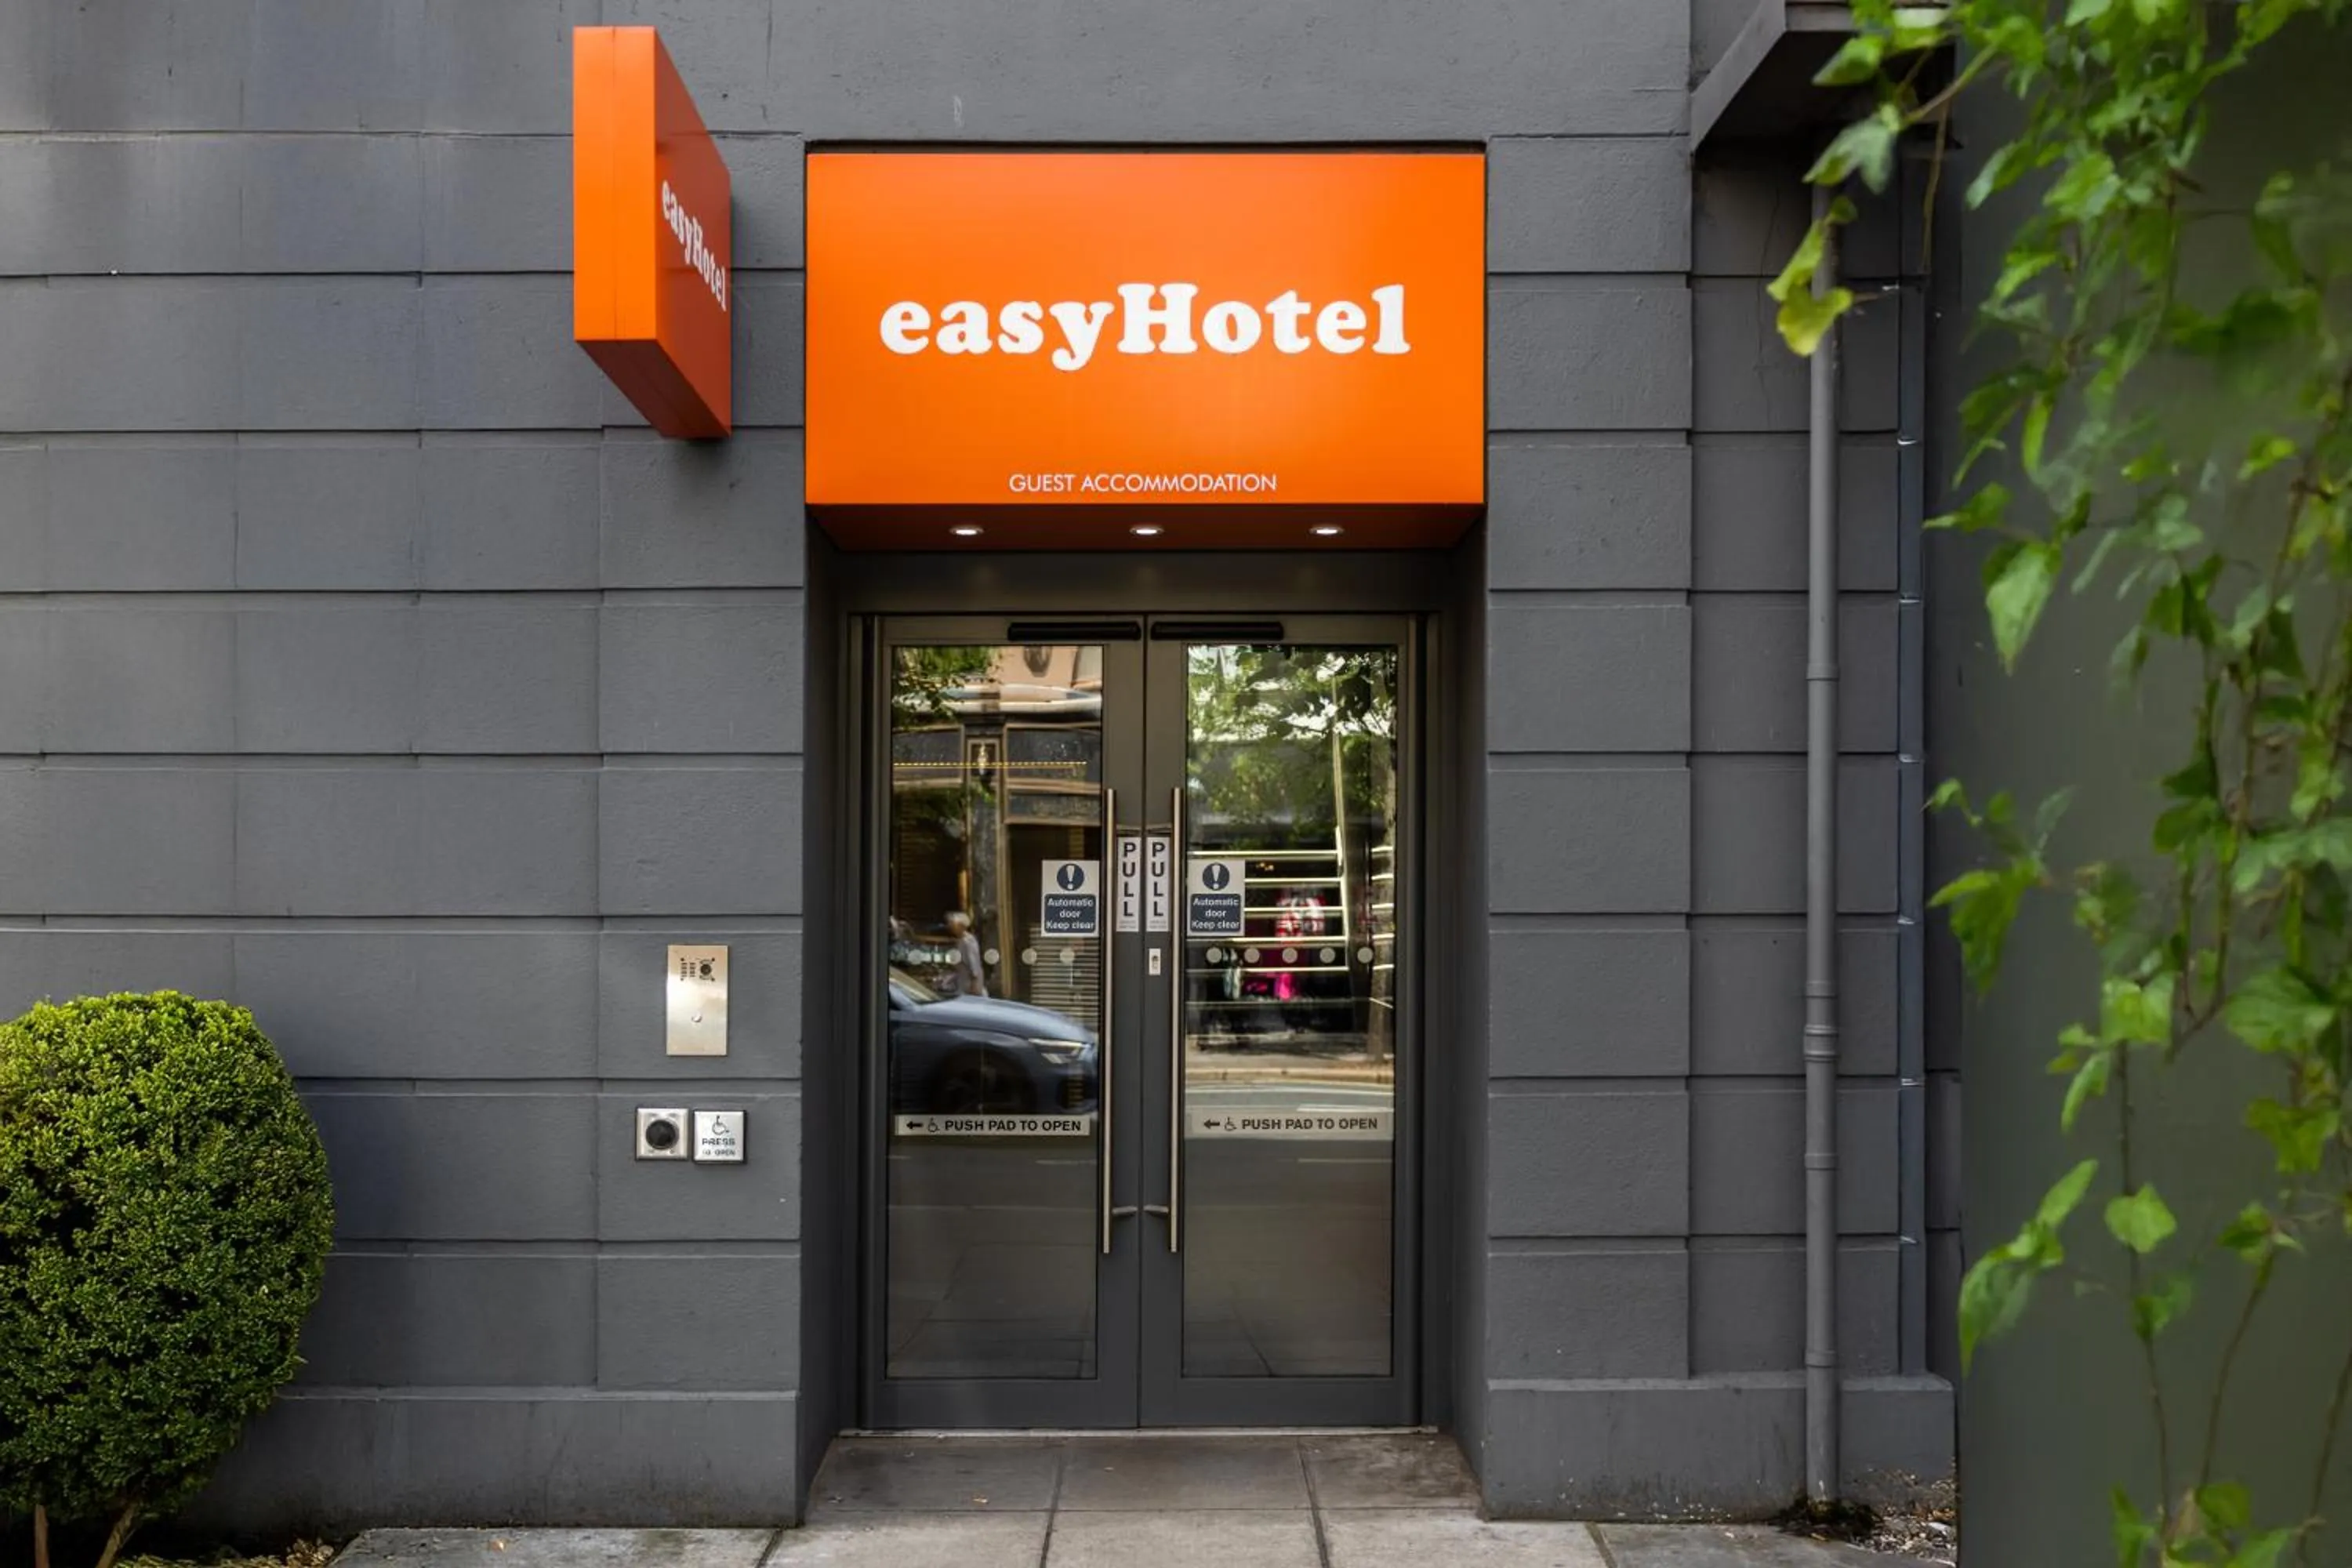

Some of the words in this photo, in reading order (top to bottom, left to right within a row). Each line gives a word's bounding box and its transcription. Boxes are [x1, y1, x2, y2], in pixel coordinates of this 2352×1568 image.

[661, 180, 728, 312] easyHotel
[880, 282, 1411, 371] easyHotel
[1008, 473, 1076, 492] GUEST
[1081, 473, 1278, 492] ACCOMMODATION
[1122, 841, 1137, 917] PULL
[1151, 841, 1166, 917] PULL
[1047, 898, 1094, 907] Automatic
[1192, 897, 1240, 907] Automatic
[1059, 909, 1080, 918] door
[1205, 909, 1227, 918] door
[1046, 920, 1070, 931] Keep
[1072, 920, 1094, 929] clear
[1192, 920, 1216, 931] Keep
[1217, 920, 1240, 929] clear
[944, 1120, 985, 1131] PUSH
[988, 1120, 1017, 1131] PAD
[1019, 1120, 1040, 1131] TO
[1041, 1120, 1082, 1131] OPEN
[1241, 1118, 1282, 1130] PUSH
[1285, 1118, 1314, 1130] PAD
[1316, 1118, 1336, 1130] TO
[1338, 1118, 1378, 1130] OPEN
